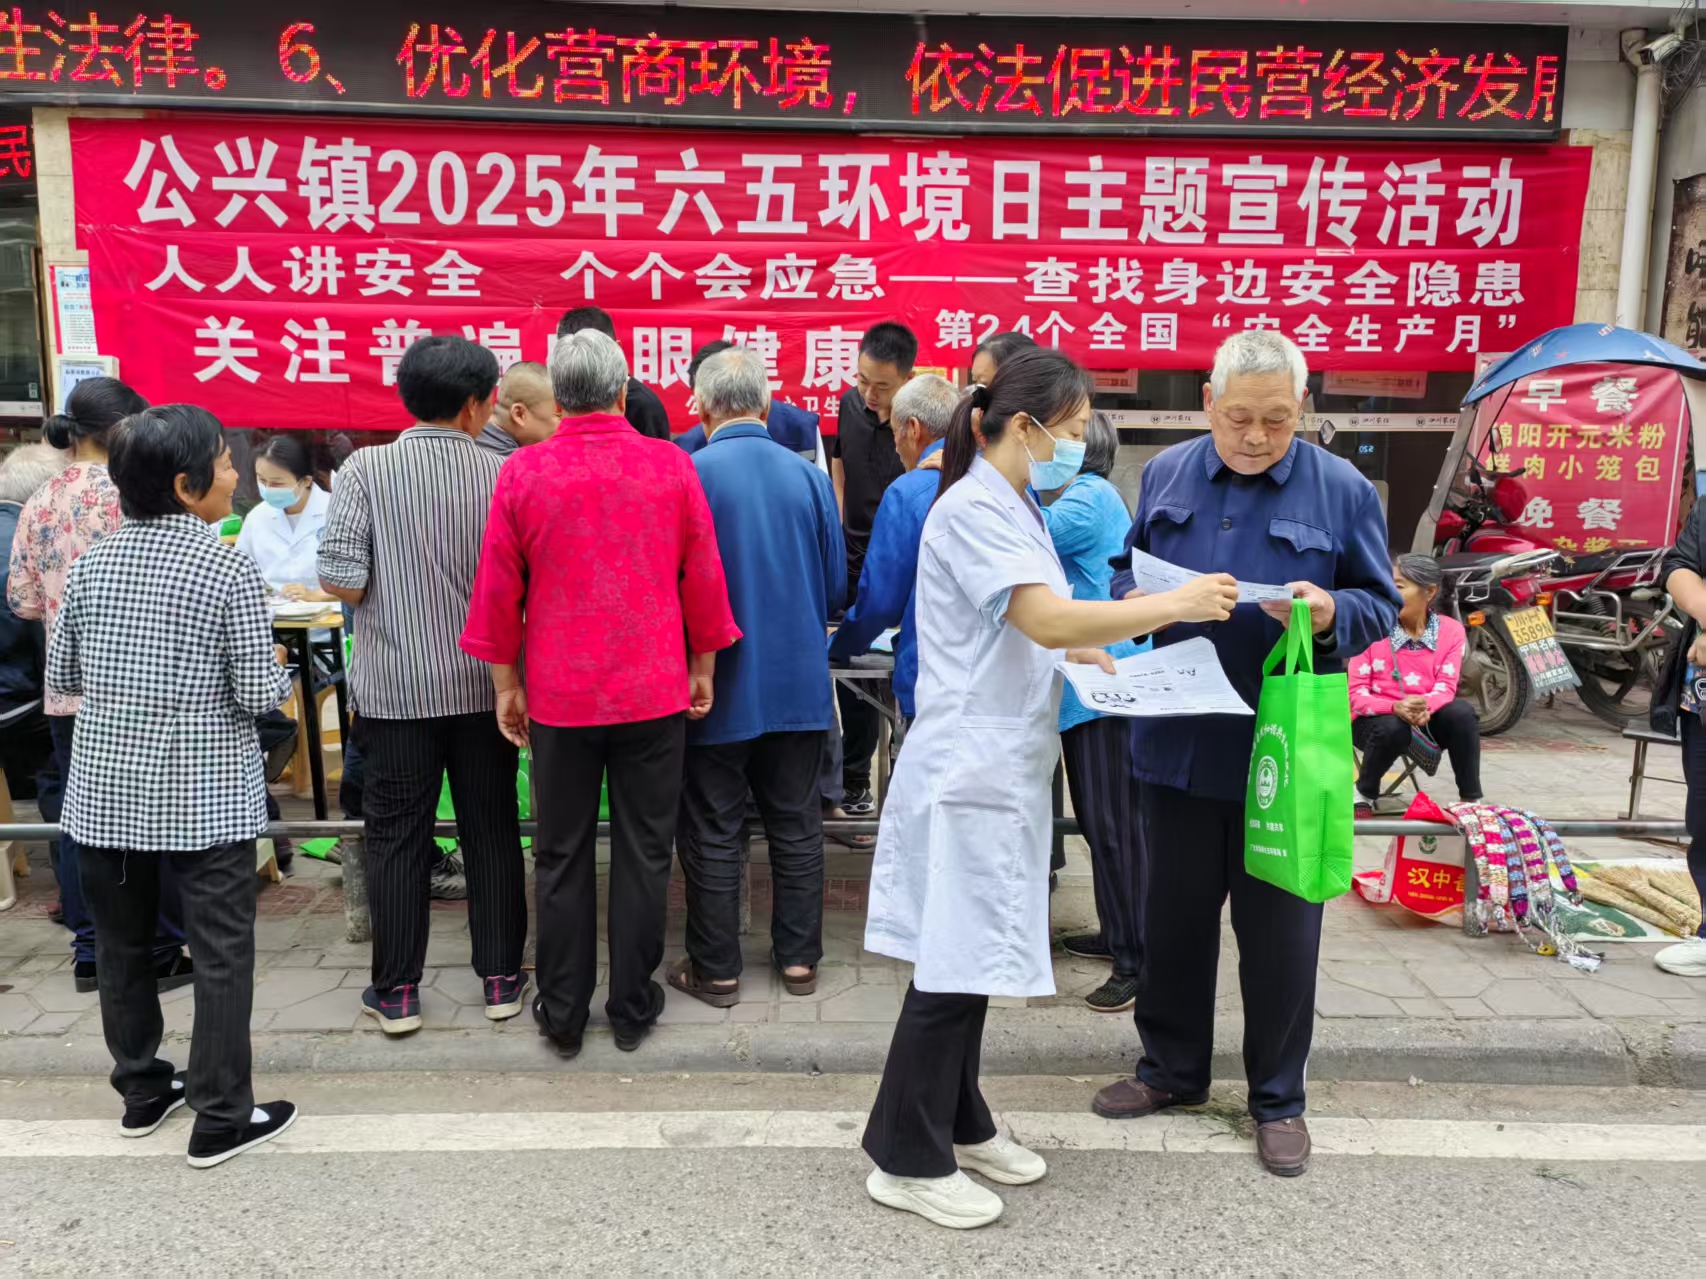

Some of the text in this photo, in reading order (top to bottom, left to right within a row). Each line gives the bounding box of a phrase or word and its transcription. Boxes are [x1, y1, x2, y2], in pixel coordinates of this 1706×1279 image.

[123, 135, 1524, 248] 公兴镇2025年六五环境日主题宣传活动
[145, 245, 483, 297] 人人讲安全
[1521, 377, 1639, 413] 早餐
